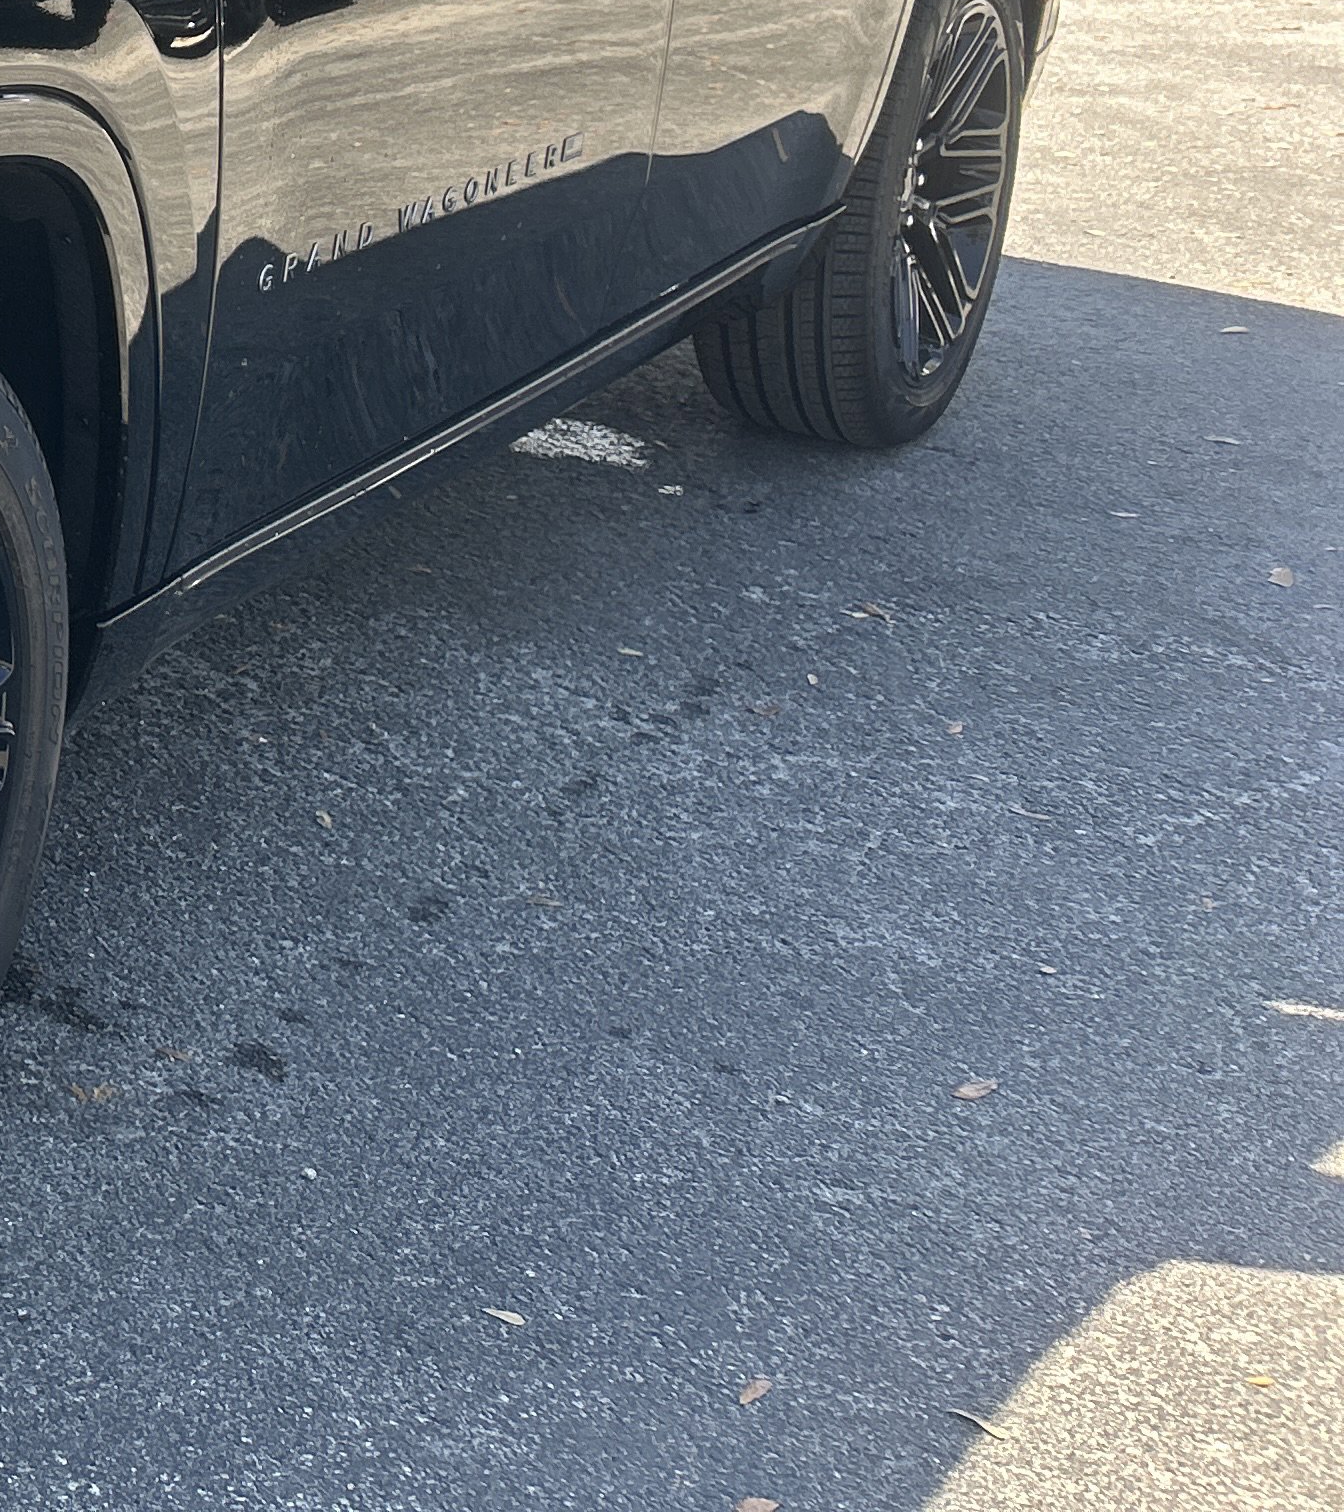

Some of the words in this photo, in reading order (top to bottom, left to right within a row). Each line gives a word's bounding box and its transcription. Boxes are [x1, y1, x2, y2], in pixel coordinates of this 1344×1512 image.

[258, 221, 374, 292] GRAND
[397, 143, 559, 234] WAGONEER
[25, 475, 66, 746] SCORPION
